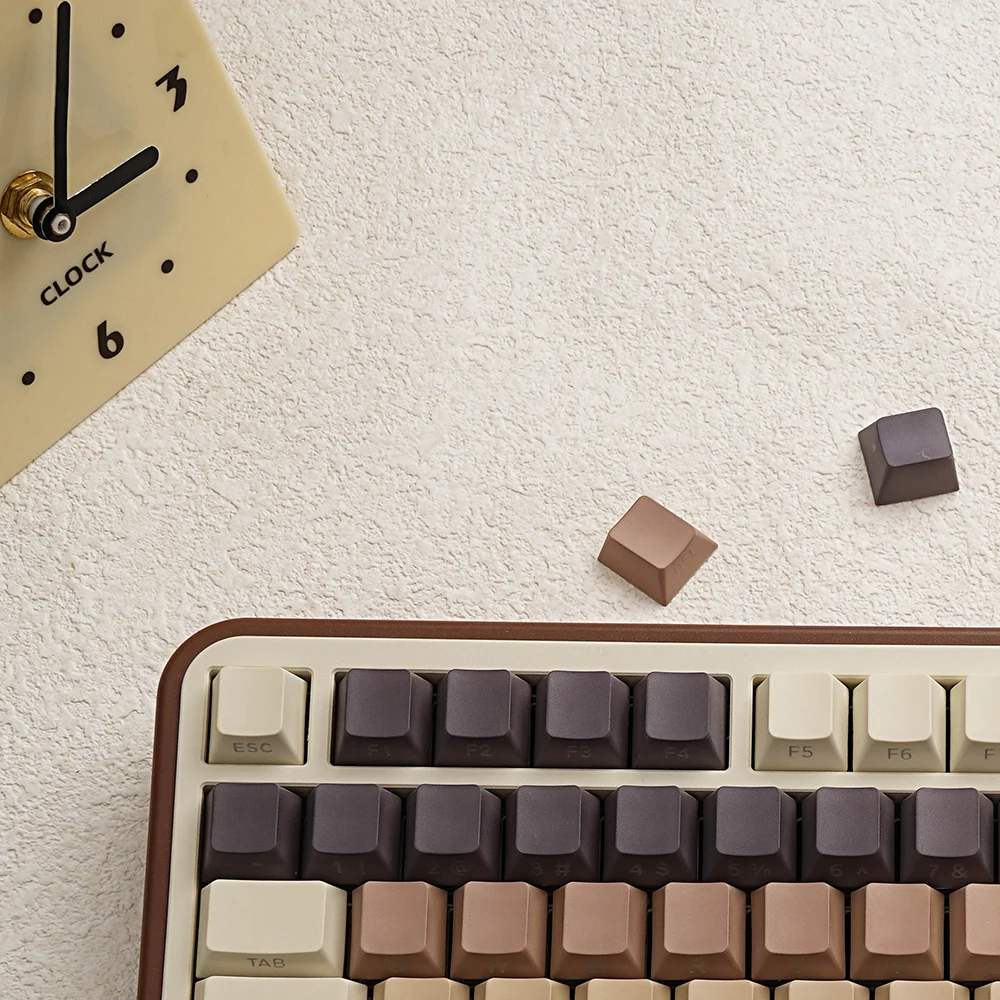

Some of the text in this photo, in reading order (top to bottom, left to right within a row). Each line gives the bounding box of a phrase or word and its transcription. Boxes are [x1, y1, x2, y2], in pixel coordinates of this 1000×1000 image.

[154, 64, 188, 113] 3
[39, 240, 114, 307] CLOCK
[96, 319, 125, 360] 6
[232, 742, 273, 754] ESC
[664, 746, 690, 760] F4
[788, 745, 814, 759] F5
[887, 747, 912, 761] F6
[247, 957, 286, 969] TAB
